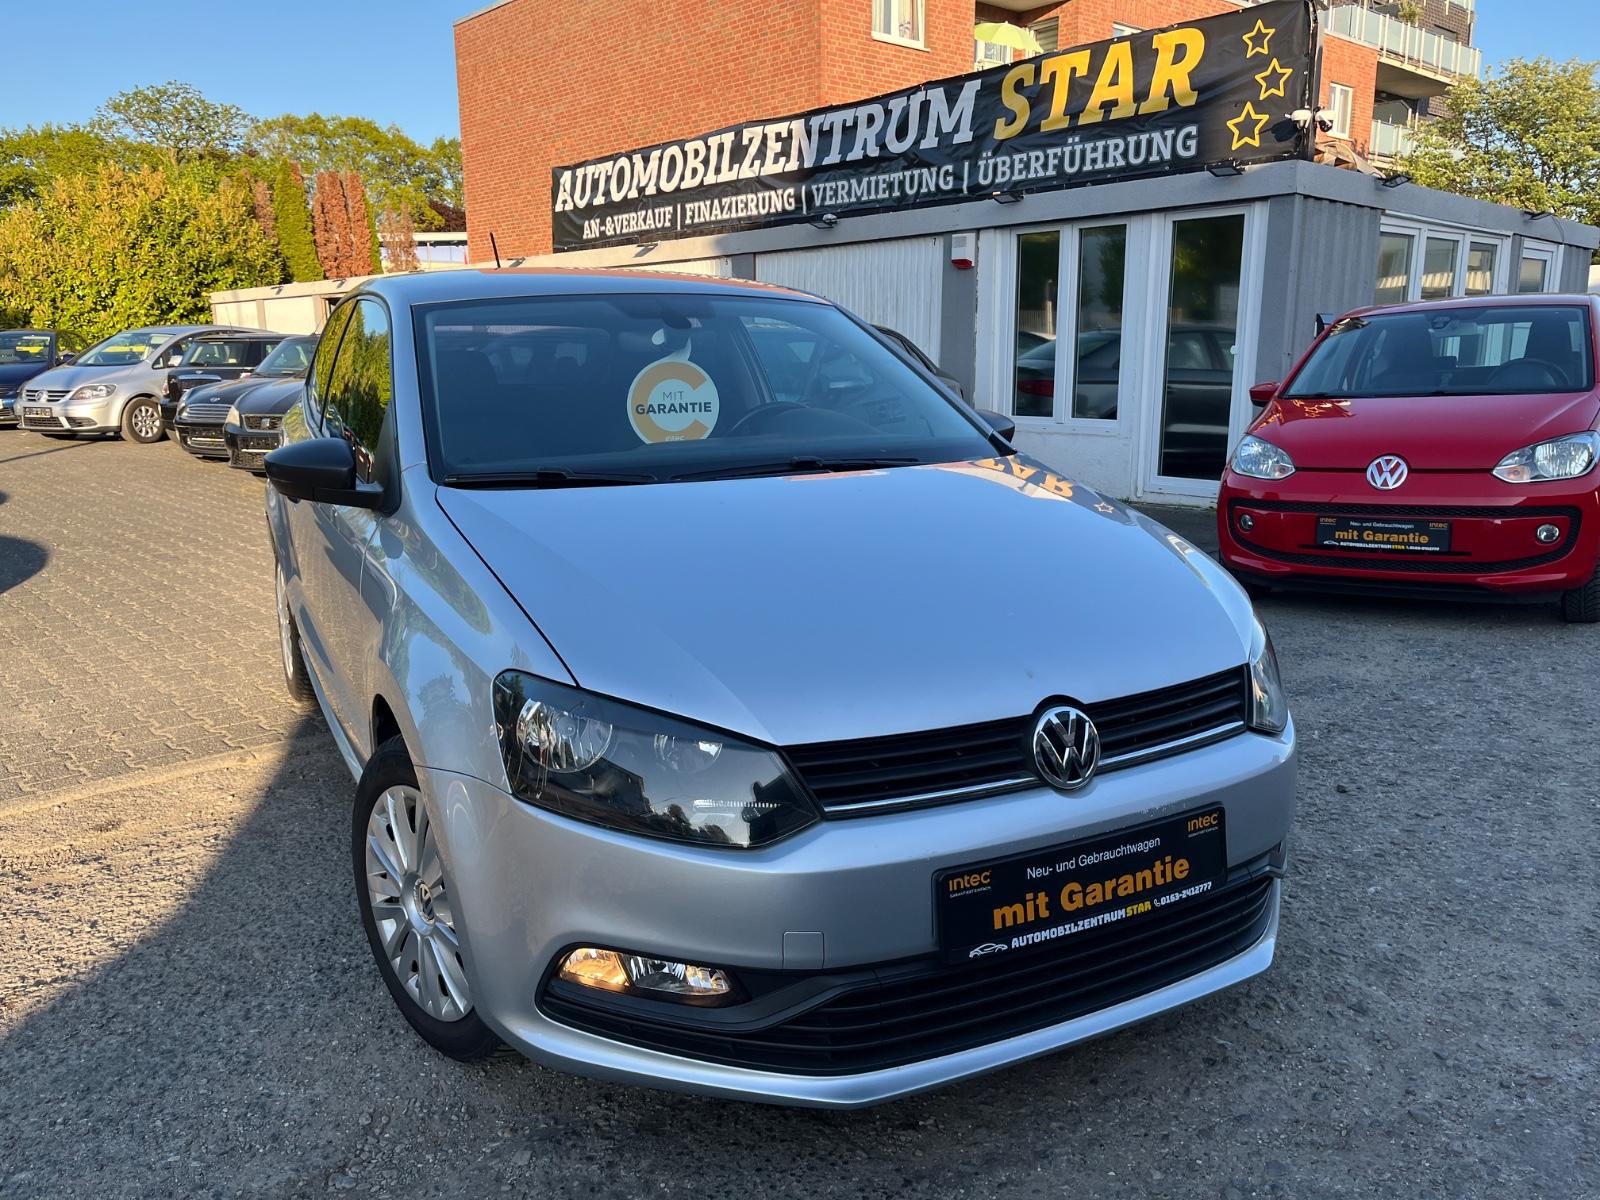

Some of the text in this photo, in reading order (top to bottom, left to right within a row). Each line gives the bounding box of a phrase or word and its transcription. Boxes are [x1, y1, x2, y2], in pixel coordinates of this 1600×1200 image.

[555, 27, 1205, 212] AUTOMOBILZENTRUM STAR
[582, 125, 1198, 239] AN-&VERKAUF FINAZIERUNG VERMIETUNG ÜBERFÜHRUNG
[635, 401, 712, 415] GARANTIE
[662, 390, 685, 401] MIT
[1335, 530, 1429, 544] mit Garantie
[1026, 837, 1161, 880] Neu- und Gebrauchtwagen
[993, 855, 1190, 930] mit Garantie
